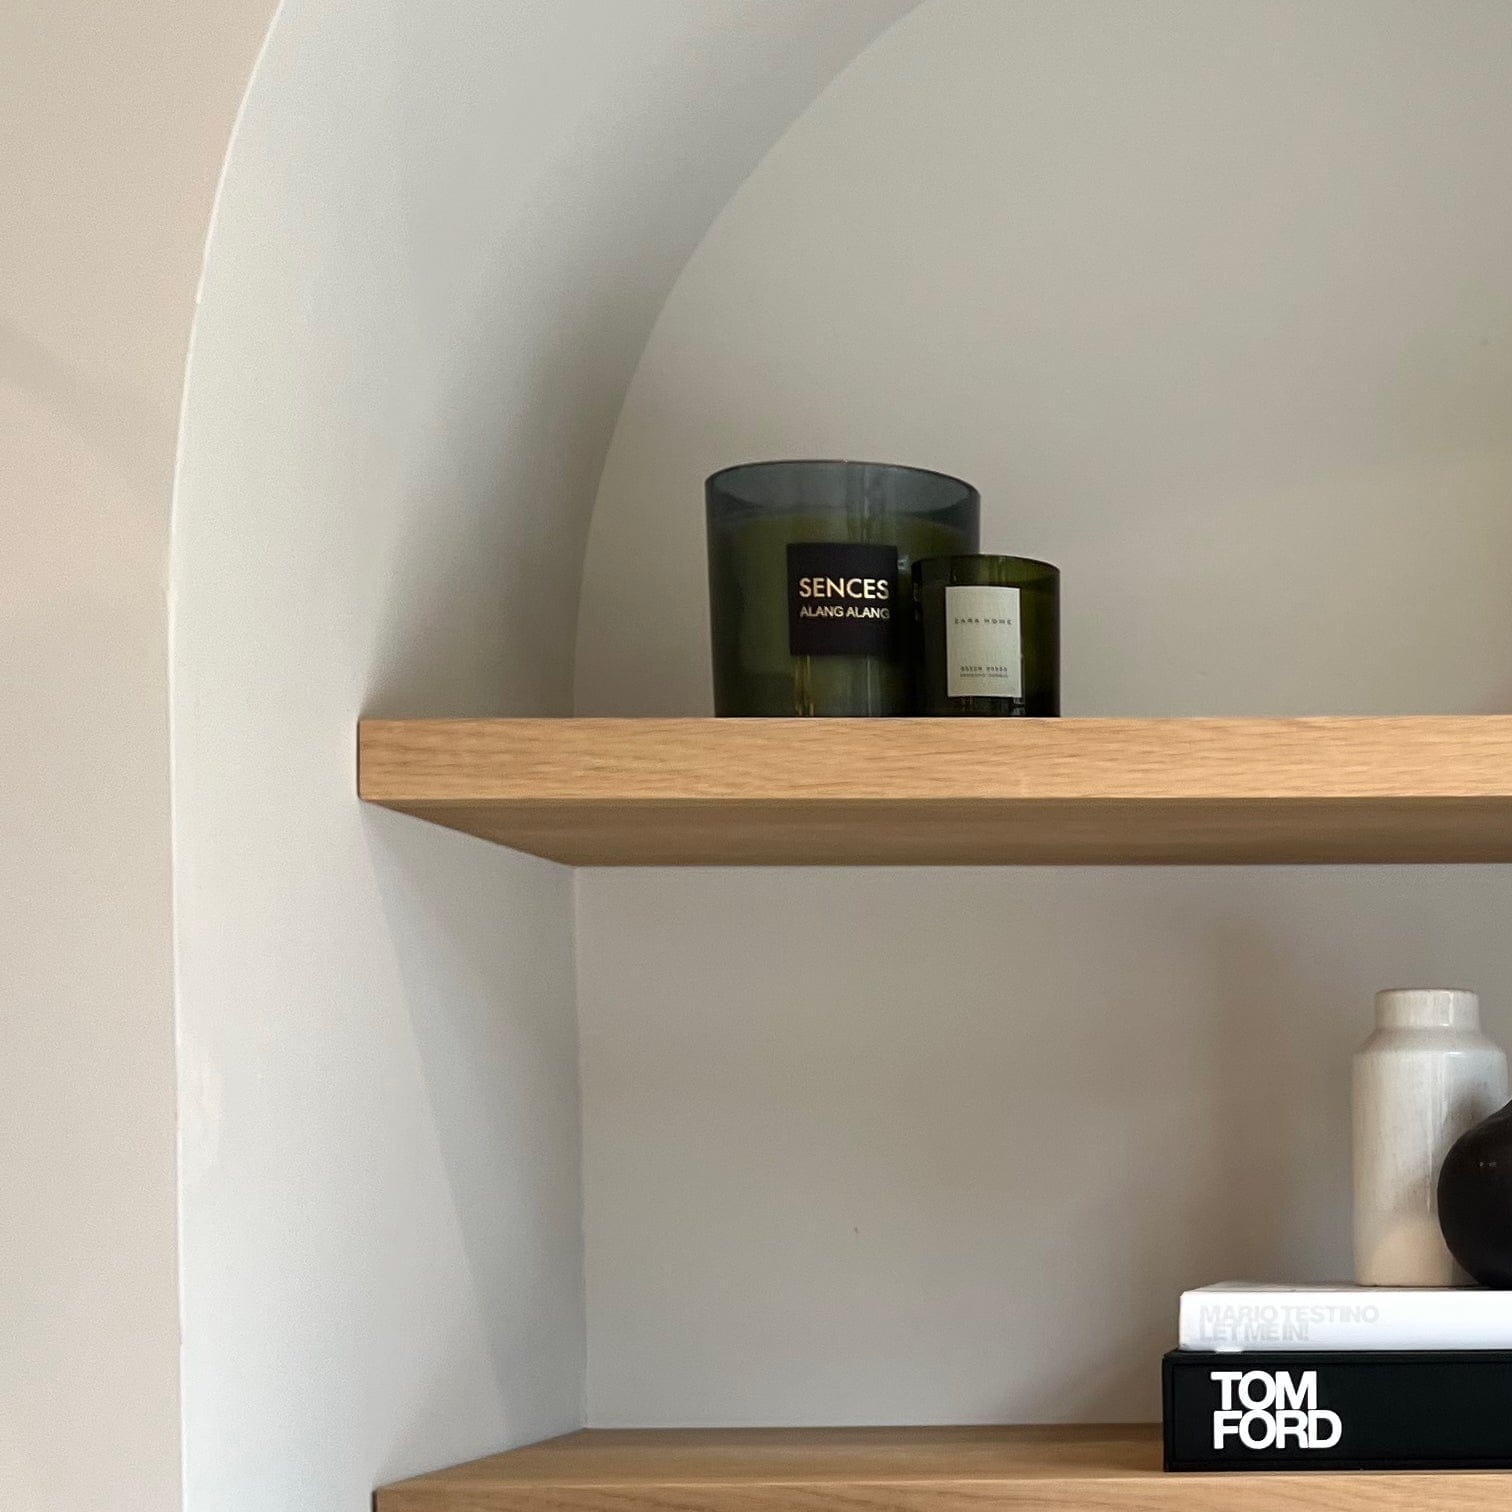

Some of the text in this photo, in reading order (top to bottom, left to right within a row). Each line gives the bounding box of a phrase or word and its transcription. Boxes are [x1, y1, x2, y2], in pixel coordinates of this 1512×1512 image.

[798, 577, 890, 600] SENCES
[799, 605, 890, 620] ALANG ALANG
[1200, 1304, 1380, 1324] MARIO TESTINO
[1200, 1322, 1309, 1342] LET ME IN!
[1210, 1370, 1317, 1410] TOM
[1213, 1409, 1343, 1450] FORD
